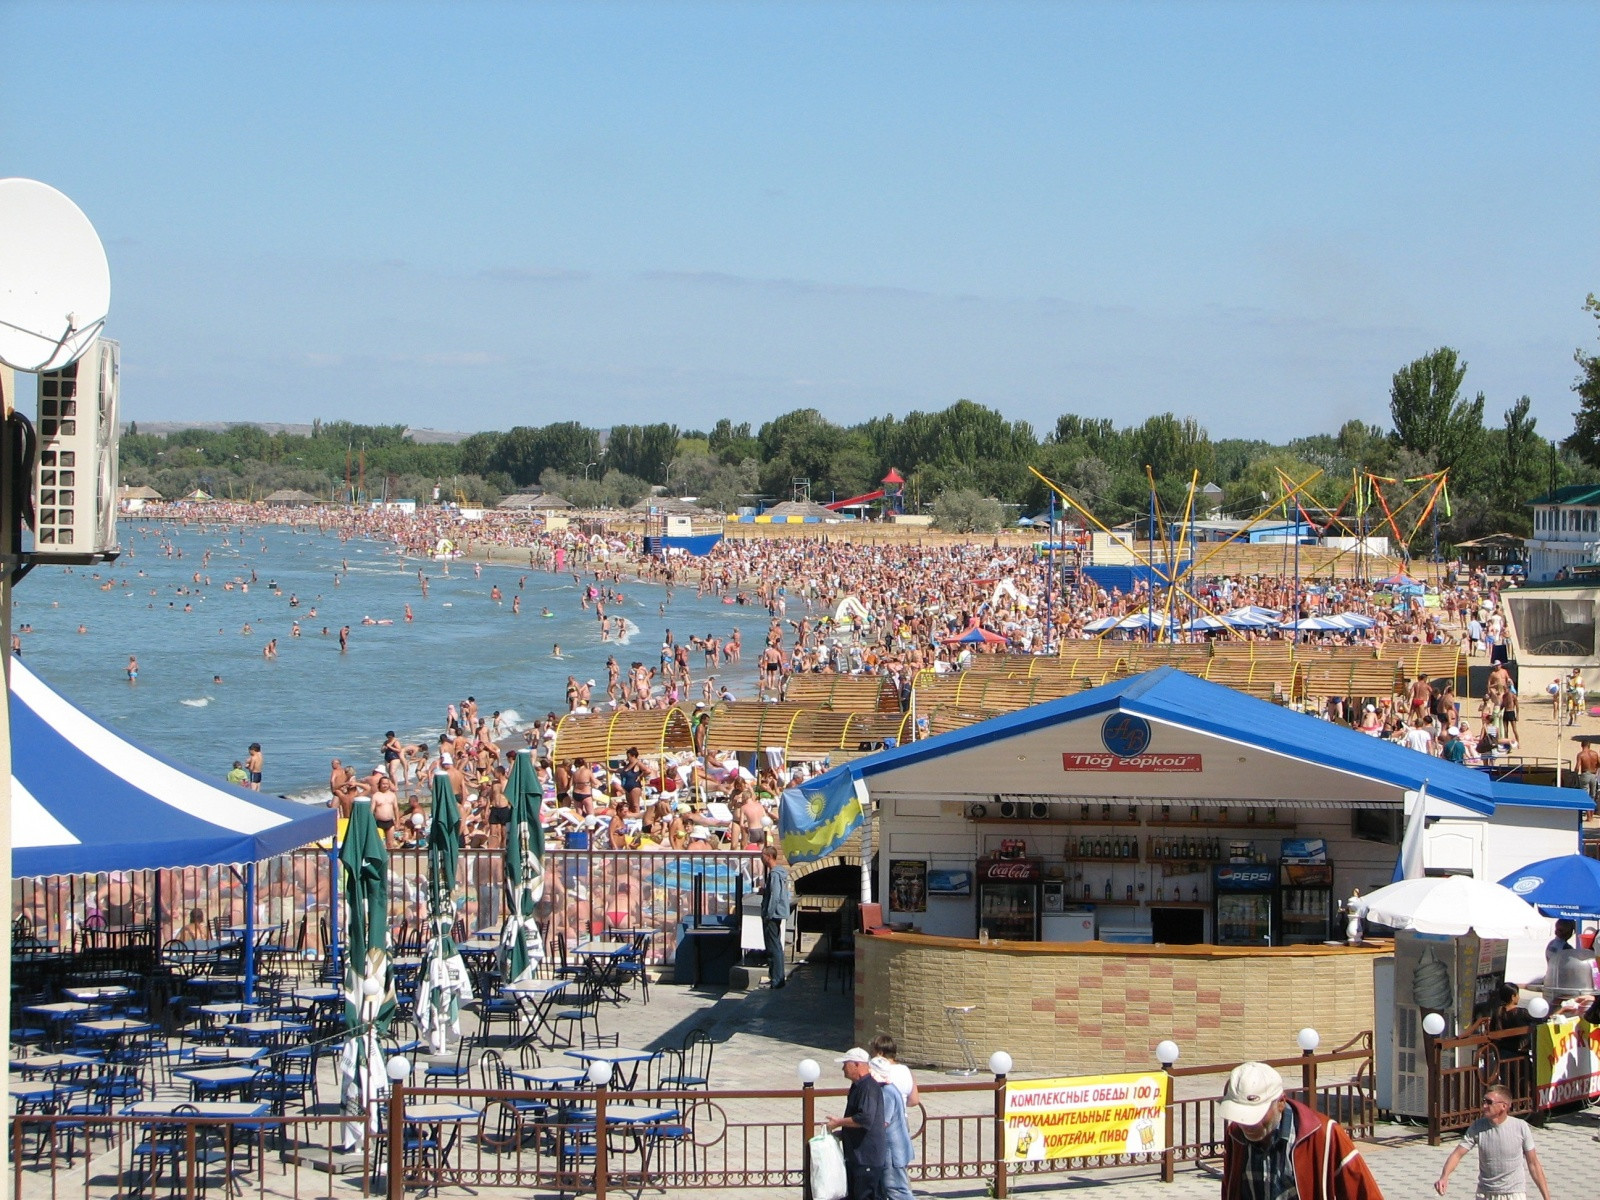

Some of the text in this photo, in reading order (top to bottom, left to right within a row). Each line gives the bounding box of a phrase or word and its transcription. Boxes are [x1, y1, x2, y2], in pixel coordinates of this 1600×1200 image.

[1232, 872, 1272, 881] PEPSI
[1548, 1029, 1600, 1066] МЯГКО
[1010, 1090, 1090, 1107] КОМПЛЕКСНЫЕ
[1092, 1087, 1129, 1101] ОБЕДЫ
[1132, 1086, 1152, 1100] 100
[1009, 1106, 1161, 1128] ПРОХЛАДИТЕЛЬНЫЕ НАПИТКИ
[1043, 1129, 1129, 1147] КОКТЕЙЛИ, ПИВО
